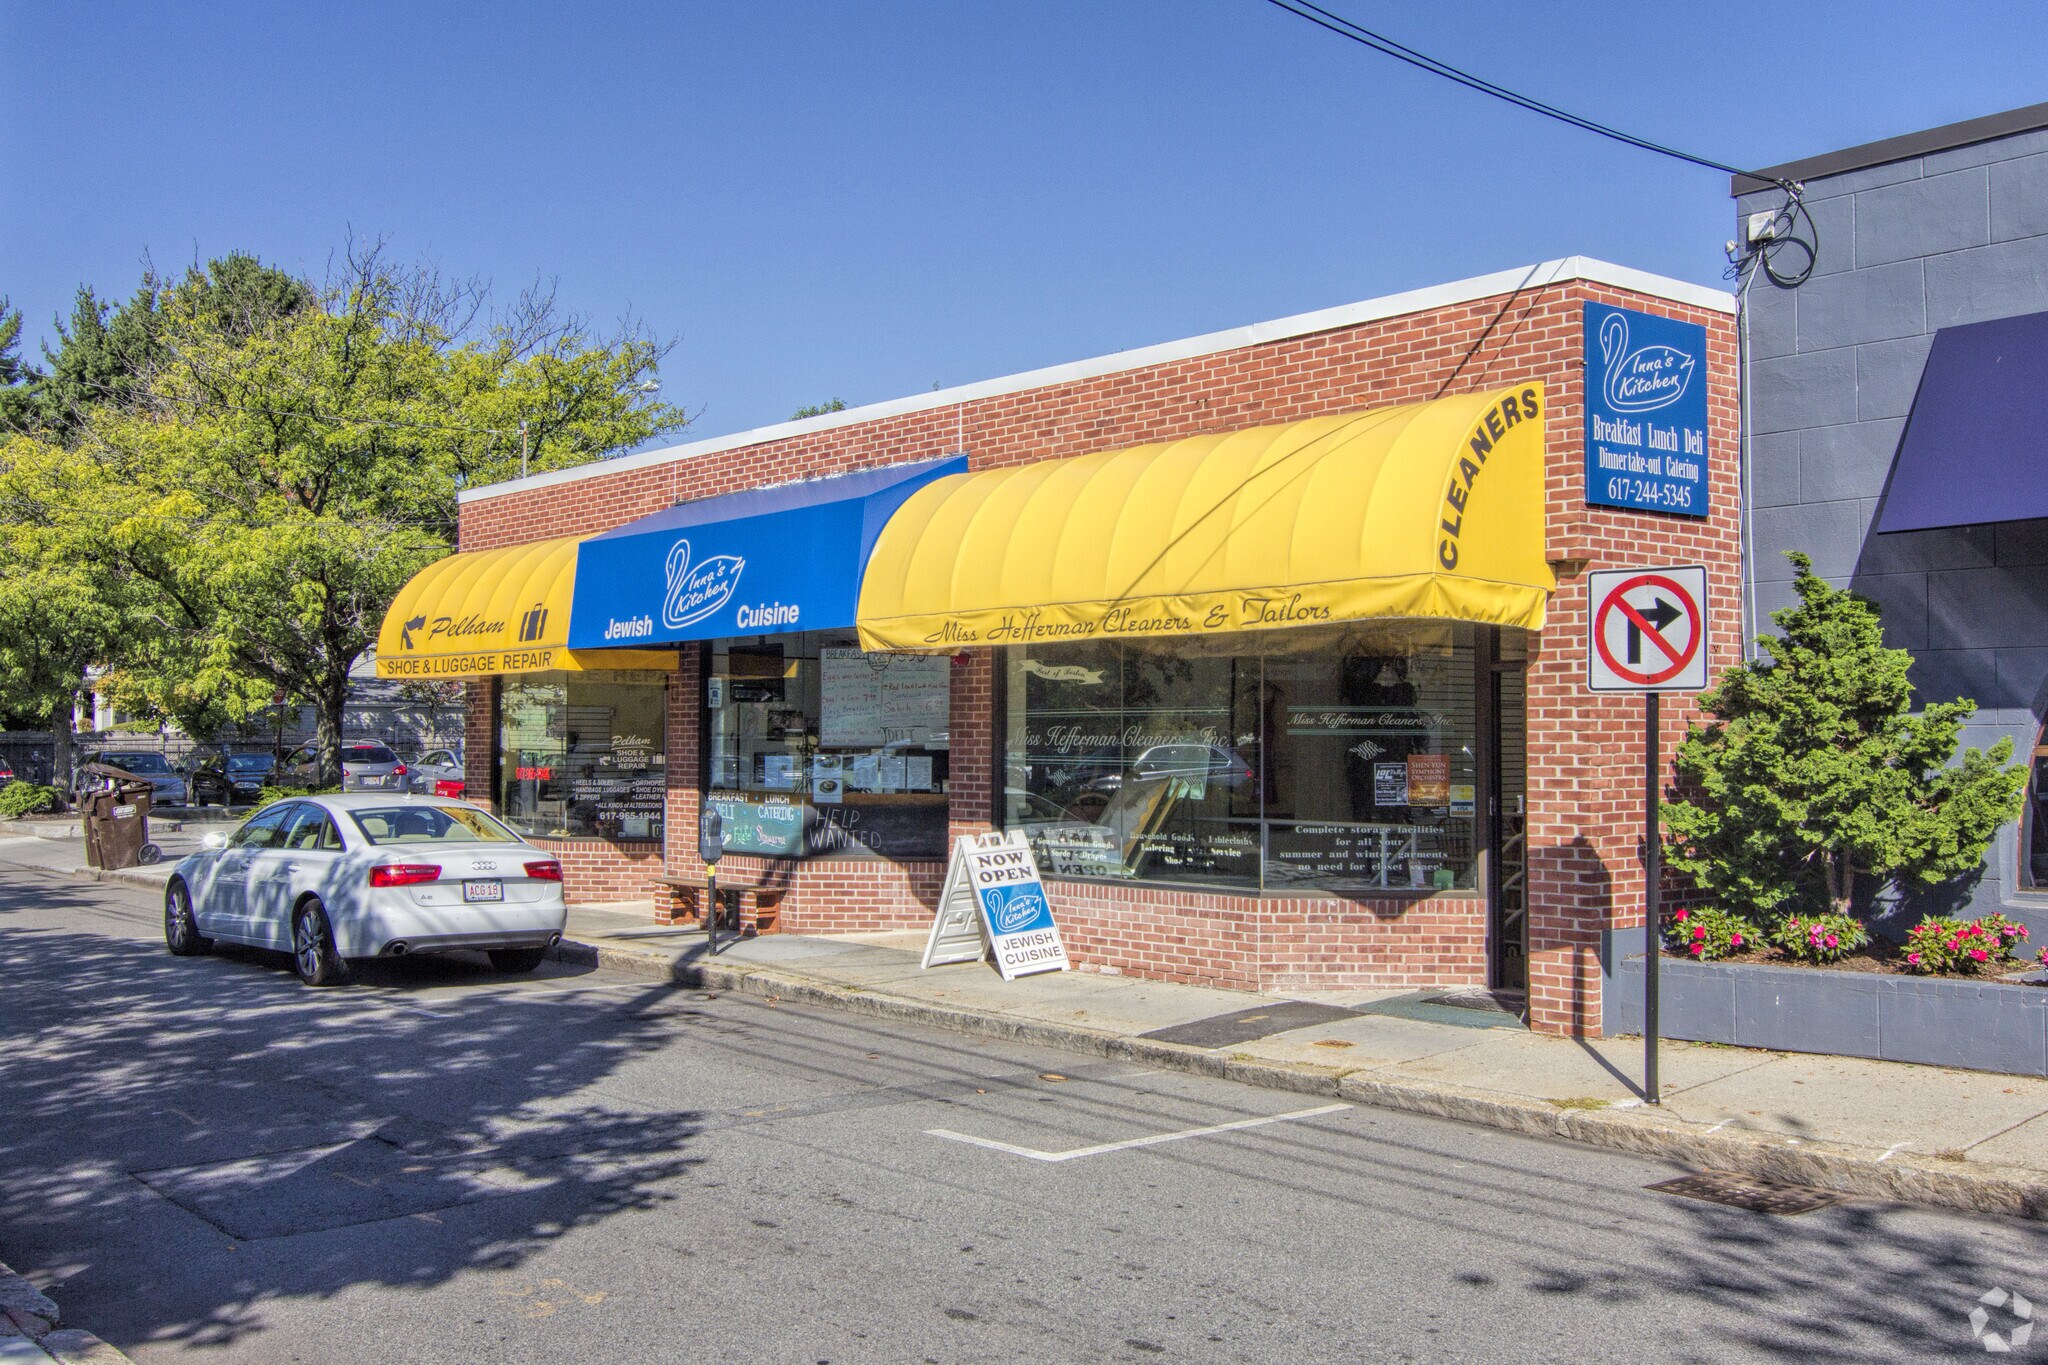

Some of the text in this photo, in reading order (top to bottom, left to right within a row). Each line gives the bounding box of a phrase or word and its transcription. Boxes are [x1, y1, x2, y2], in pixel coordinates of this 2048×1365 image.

[1632, 349, 1674, 374] Inna's
[1619, 372, 1680, 400] Kitchen
[1592, 413, 1704, 456] Breakfast Lunch Deli
[1599, 446, 1699, 483] Dinner take-out Catering
[1439, 388, 1539, 571] CLEANERS
[1608, 476, 1691, 508] 617-244-5345
[687, 560, 726, 592] Inna's
[674, 579, 730, 617] Kitchen
[736, 601, 800, 629] Cuisine
[923, 620, 980, 643] Miss
[1102, 607, 1193, 633] Cleaners
[1203, 604, 1230, 629] &
[1240, 593, 1332, 626] Tailors
[428, 613, 505, 641] Pelham
[604, 614, 653, 640] Jewish
[387, 651, 552, 675] SHOE & LUGGAGE REPAIR
[1052, 669, 1062, 679] of
[1063, 668, 1086, 678] Boston
[1287, 713, 1316, 726] Miss
[611, 734, 651, 747] Pelham
[708, 791, 790, 805] BREAKFAST LUNCH
[600, 811, 661, 820] 617-965-1944
[716, 803, 795, 822] DELI CATERING
[815, 806, 860, 830] HELP
[808, 826, 882, 850] WANTED
[1130, 831, 1168, 841] Household
[1171, 832, 1196, 842] Goods
[1294, 825, 1446, 836] Complete storage facilities
[1092, 840, 1115, 850] Goods
[1335, 837, 1404, 848] for all your
[977, 851, 1024, 869] NOW
[1081, 850, 1107, 861] Drapes
[1279, 850, 1449, 861] summer and winter garments
[979, 865, 1033, 883] OPEN
[1297, 862, 1311, 871] no
[1317, 862, 1343, 871] need
[1349, 862, 1366, 871] for
[1371, 862, 1403, 871] closet
[469, 885, 486, 896] ACG
[1008, 896, 1031, 914] Inna's
[1005, 906, 1037, 927] Kitchen
[1003, 932, 1055, 951] JEWISH
[1005, 945, 1063, 965] CUISINE
